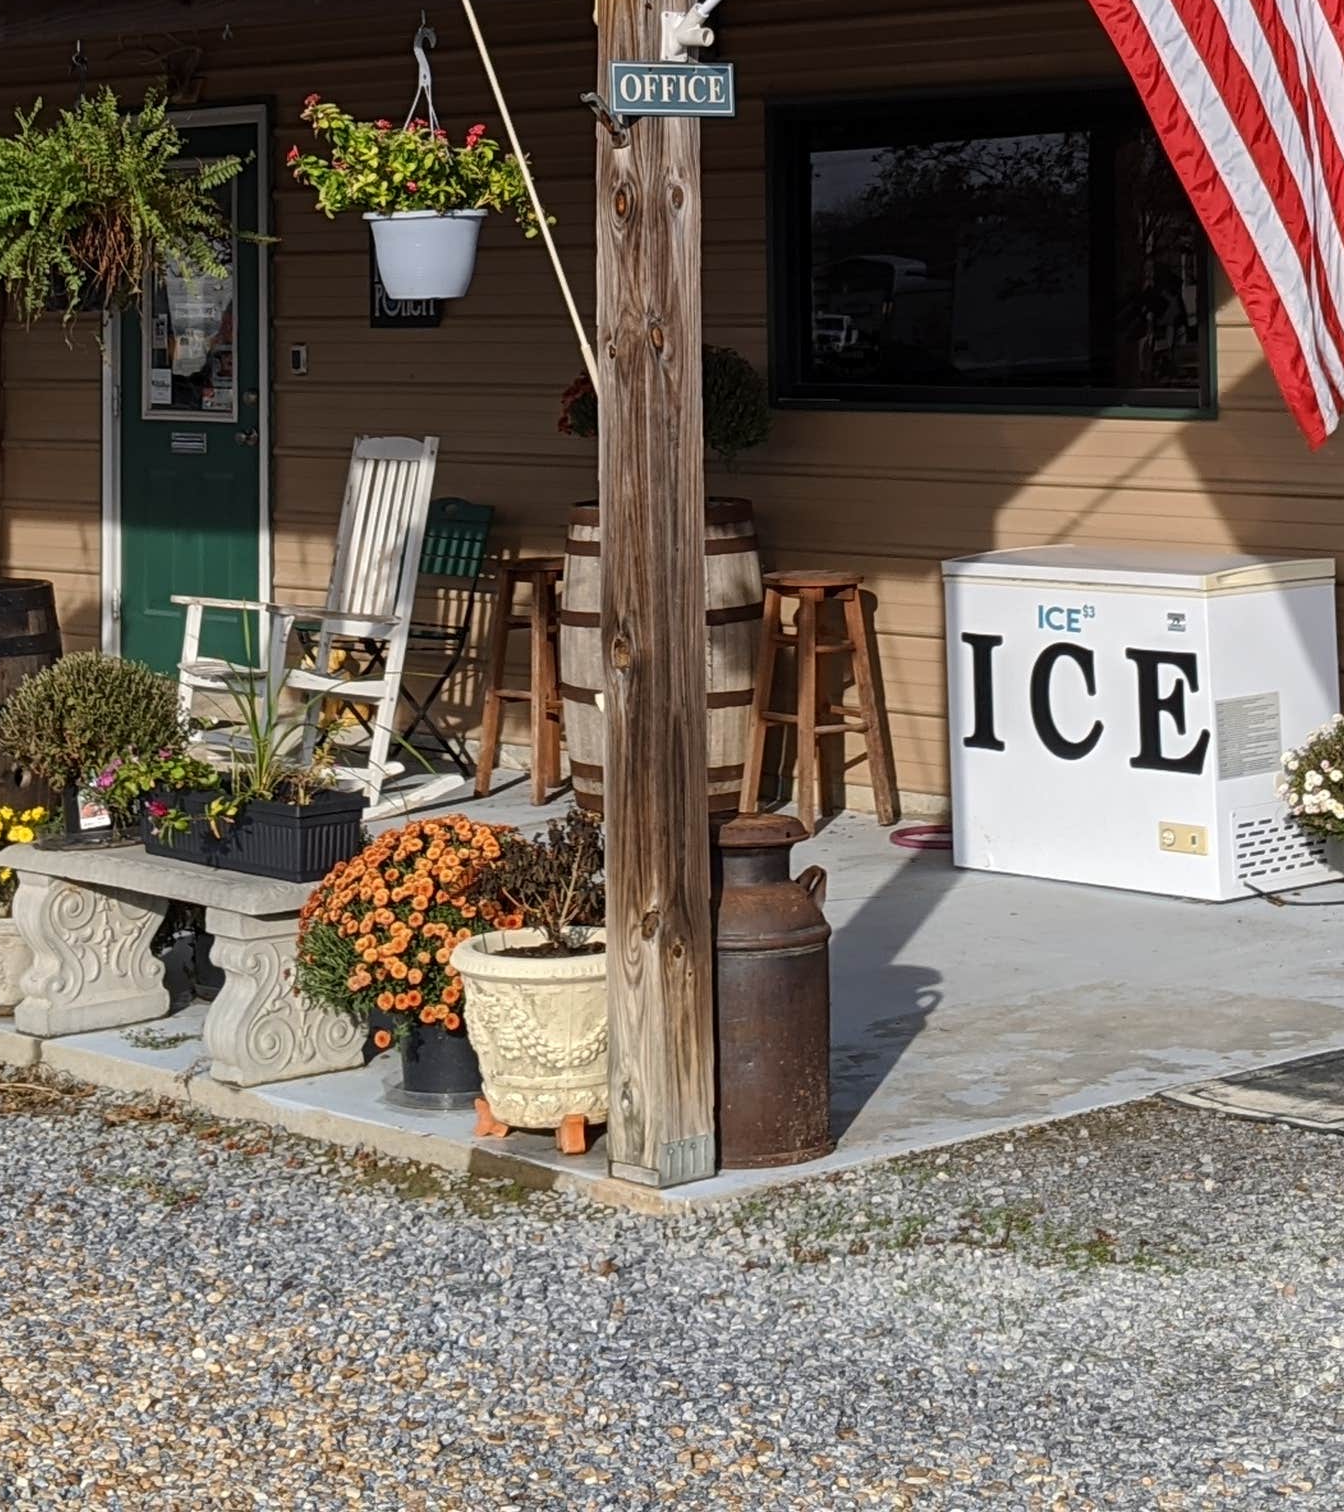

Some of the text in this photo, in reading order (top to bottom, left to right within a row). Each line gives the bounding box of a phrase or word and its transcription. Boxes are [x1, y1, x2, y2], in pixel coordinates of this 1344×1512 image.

[620, 73, 726, 103] OFFICE
[1037, 603, 1096, 633] ICE $3
[961, 631, 1211, 775] ICE
